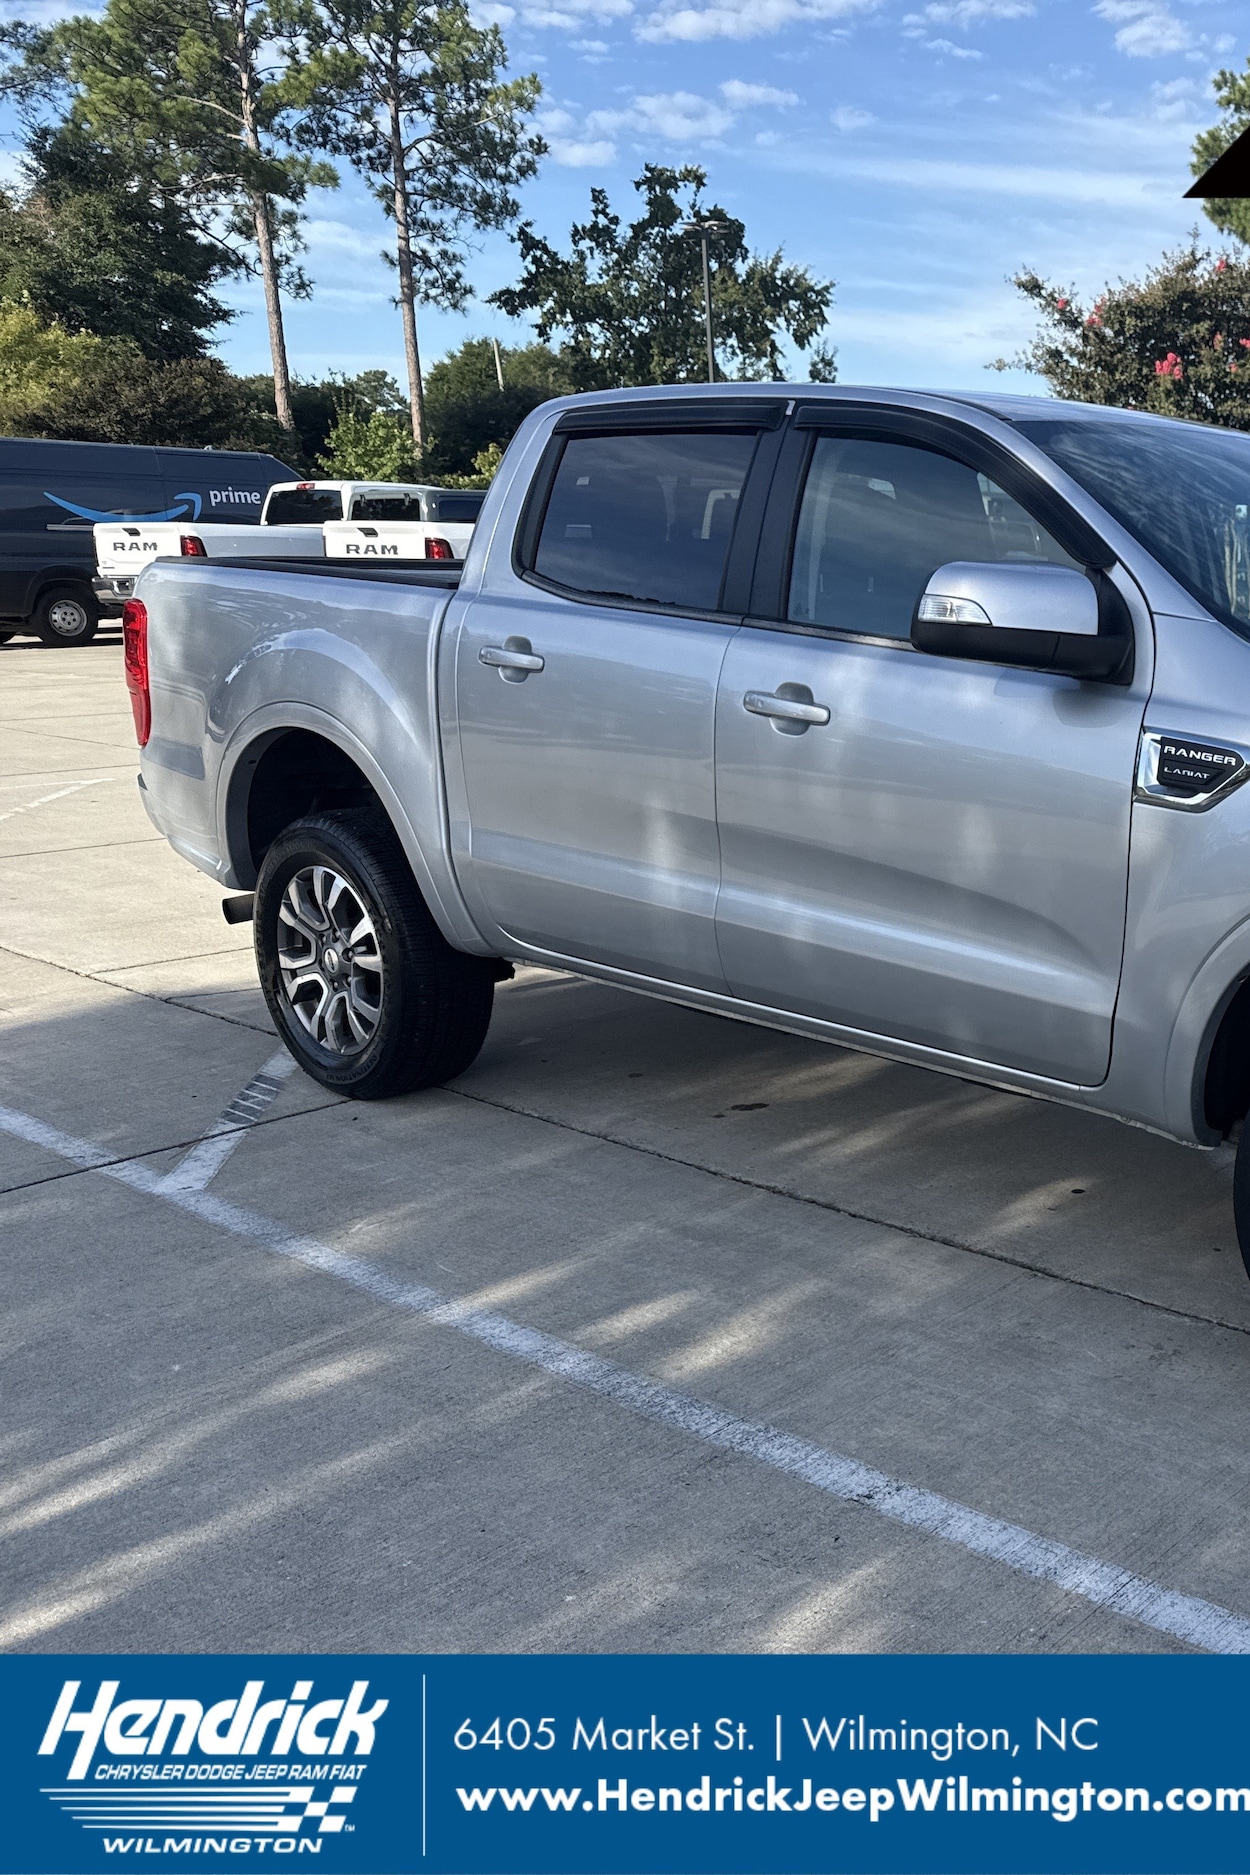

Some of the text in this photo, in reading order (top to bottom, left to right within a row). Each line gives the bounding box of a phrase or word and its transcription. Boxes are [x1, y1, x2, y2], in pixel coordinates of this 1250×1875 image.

[209, 486, 261, 507] prime
[112, 542, 158, 551] RAM
[346, 544, 399, 555] RAM
[1163, 745, 1238, 766] RANGER
[1163, 766, 1211, 780] LARIAT
